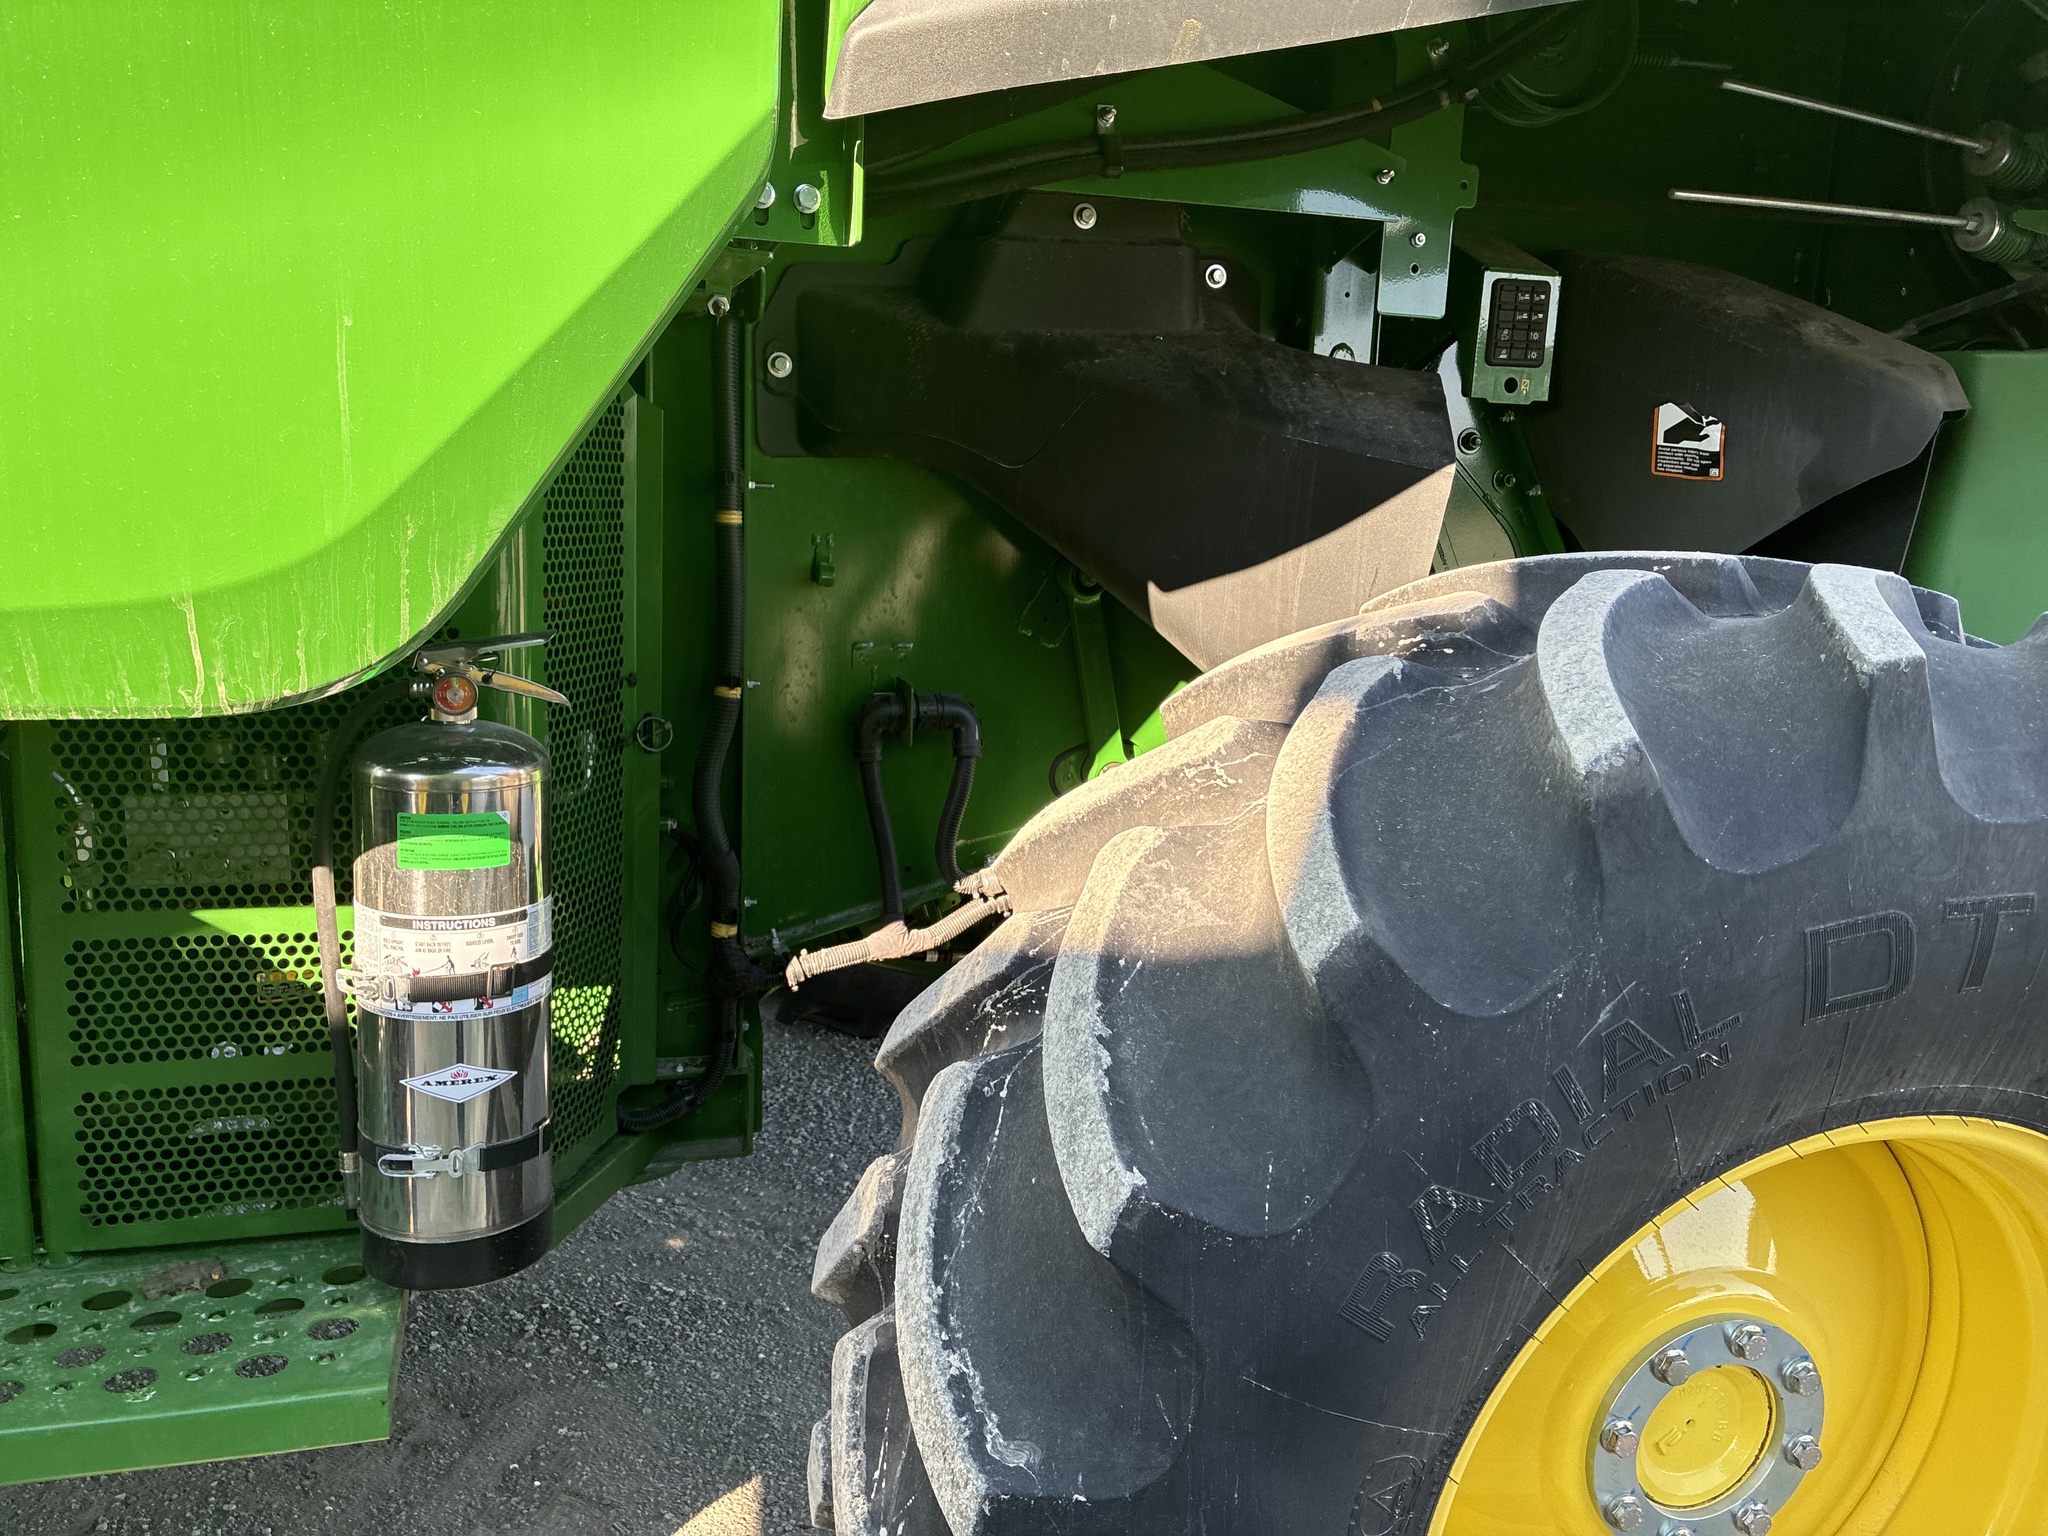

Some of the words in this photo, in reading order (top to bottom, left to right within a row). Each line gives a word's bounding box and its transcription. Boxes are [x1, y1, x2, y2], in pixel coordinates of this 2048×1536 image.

[412, 917, 496, 930] INSTRUCTIONS
[421, 1074, 498, 1086] AMEREX
[1337, 986, 1743, 1344] RADIAL
[1803, 891, 2038, 1026] DT
[1408, 1249, 1484, 1341] ALL
[1483, 1040, 1733, 1231] TRACTION
